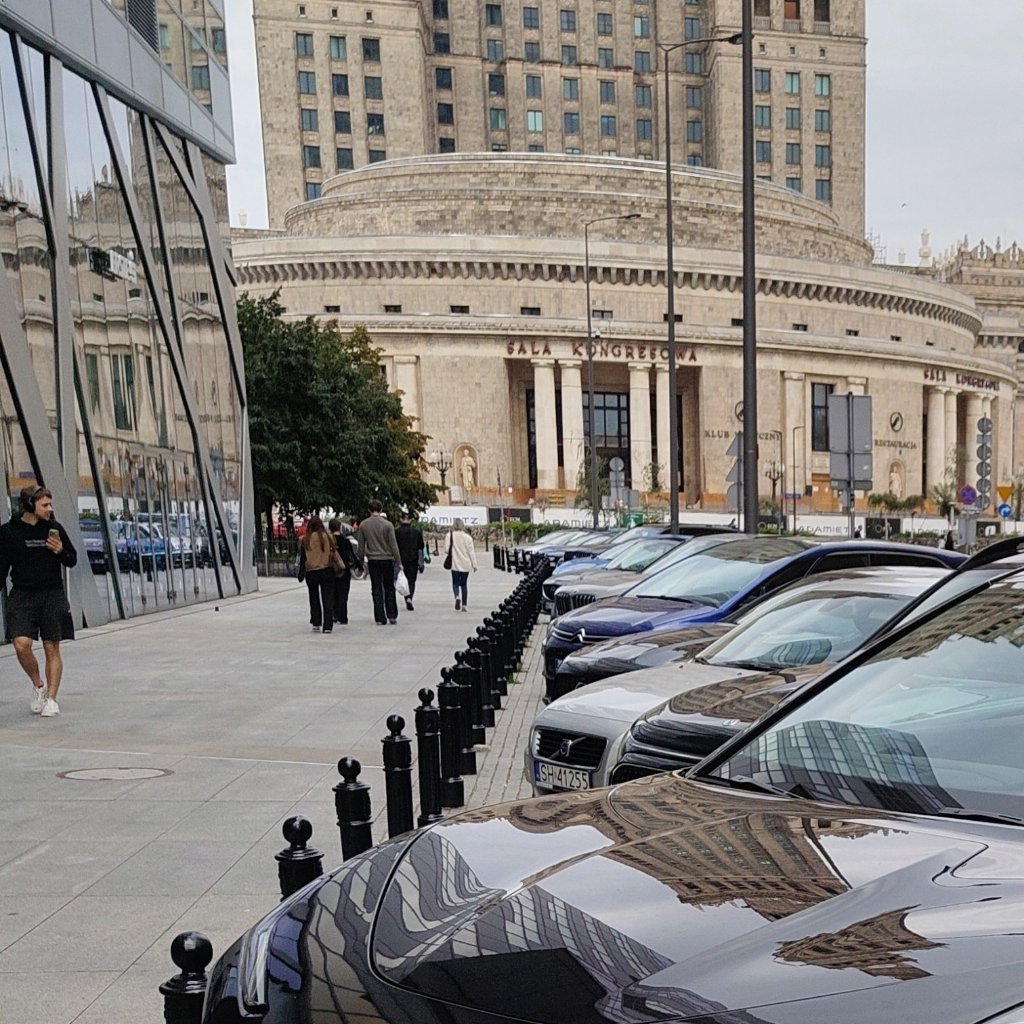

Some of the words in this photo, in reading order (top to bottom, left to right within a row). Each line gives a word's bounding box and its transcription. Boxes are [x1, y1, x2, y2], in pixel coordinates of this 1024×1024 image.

[506, 340, 552, 355] SALA
[705, 430, 729, 438] KLUB
[541, 765, 554, 783] SH
[557, 768, 589, 790] 41255
